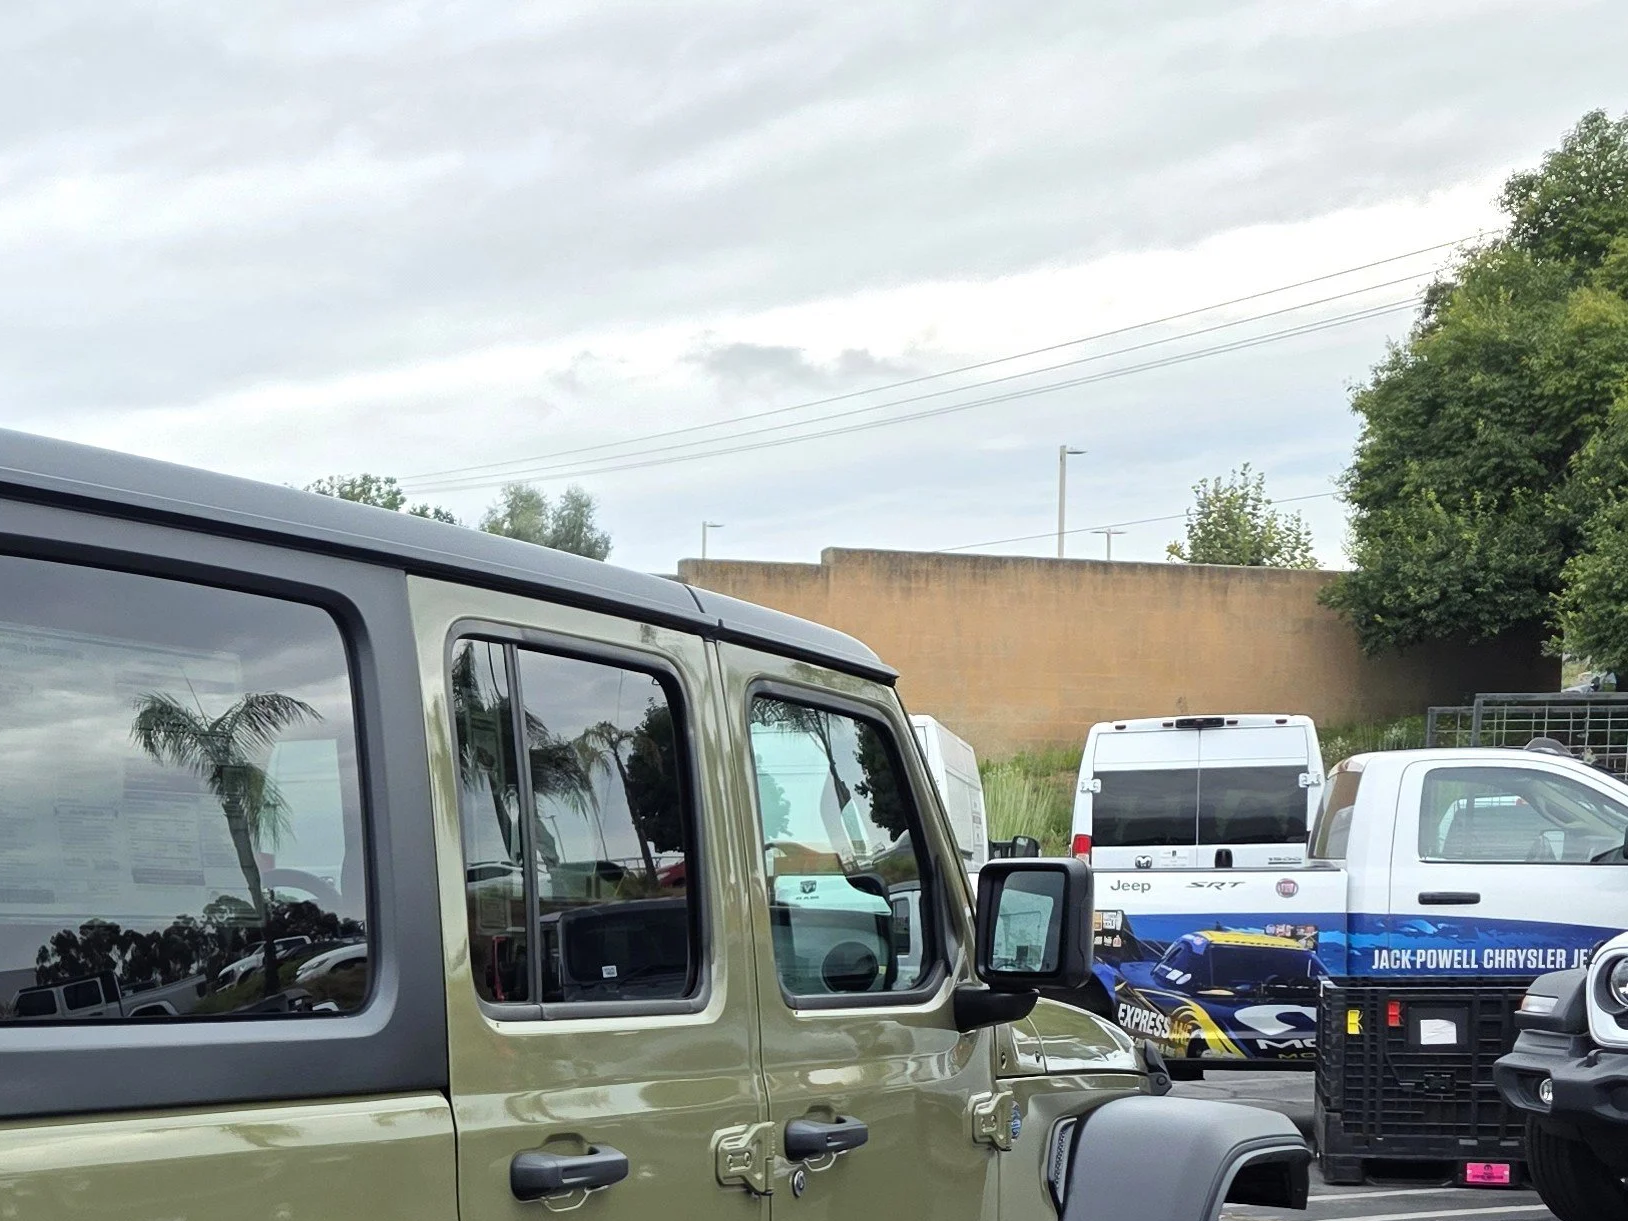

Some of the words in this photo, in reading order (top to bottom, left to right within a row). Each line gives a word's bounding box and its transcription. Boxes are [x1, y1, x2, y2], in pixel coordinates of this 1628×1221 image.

[1110, 880, 1152, 893] Jeep
[1185, 881, 1246, 891] SRT
[1371, 949, 1412, 969] JACK
[1416, 949, 1479, 969] POWELL
[1483, 948, 1567, 969] CHRYSLER
[1570, 948, 1593, 969] JE
[1117, 1003, 1171, 1039] EXPRESS
